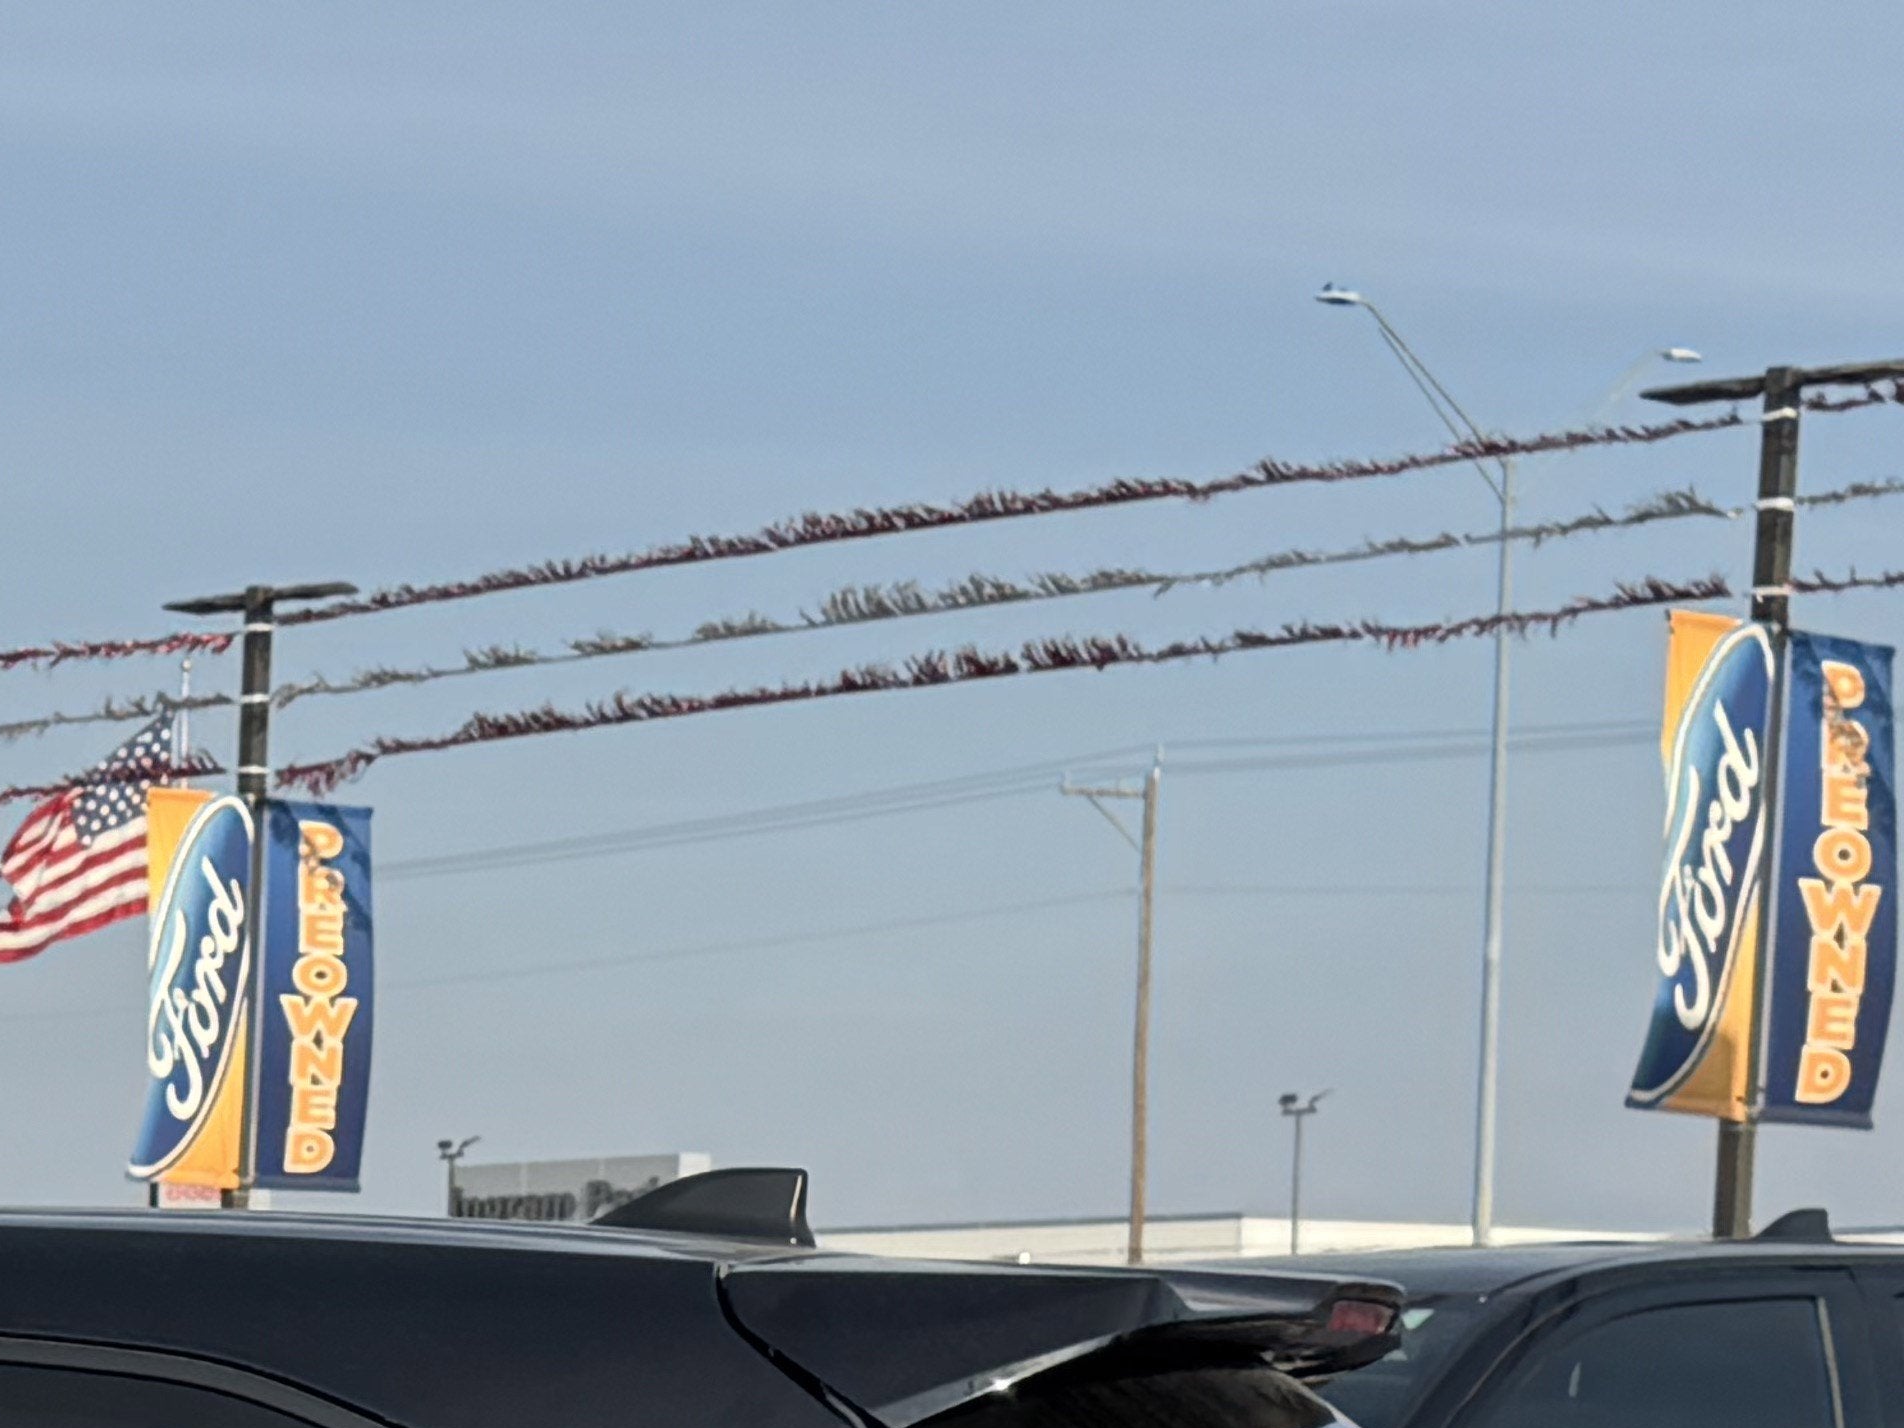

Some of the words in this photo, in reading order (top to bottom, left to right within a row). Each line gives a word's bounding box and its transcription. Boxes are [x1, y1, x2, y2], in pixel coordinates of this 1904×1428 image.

[148, 856, 245, 1121] Ford
[280, 819, 358, 1174] PREOWNED
[1657, 699, 1760, 1030] Ford
[1795, 660, 1882, 1104] PREOWNED
